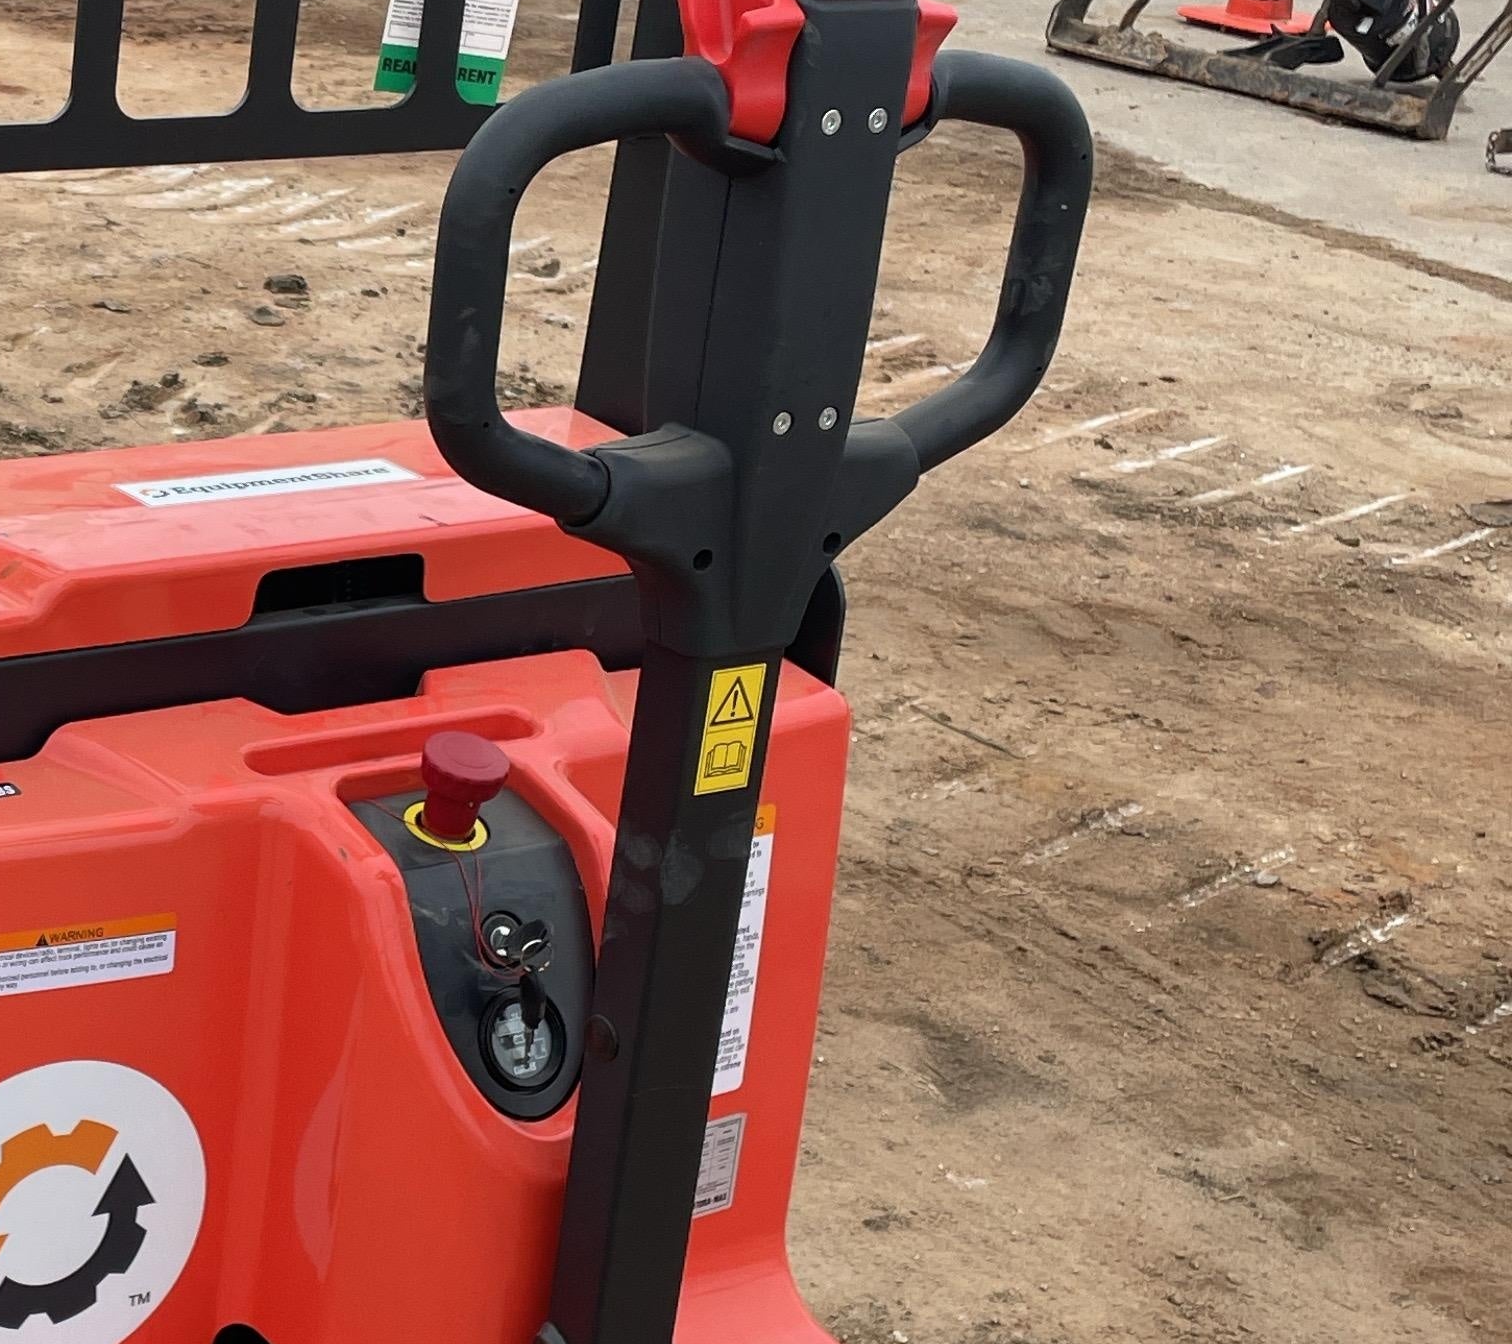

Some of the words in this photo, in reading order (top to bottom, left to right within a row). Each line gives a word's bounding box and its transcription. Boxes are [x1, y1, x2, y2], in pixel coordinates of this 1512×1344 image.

[457, 67, 497, 85] RENT
[170, 466, 391, 498] EquipmentShare
[48, 927, 105, 944] WARNING
[128, 1291, 152, 1307] TM
